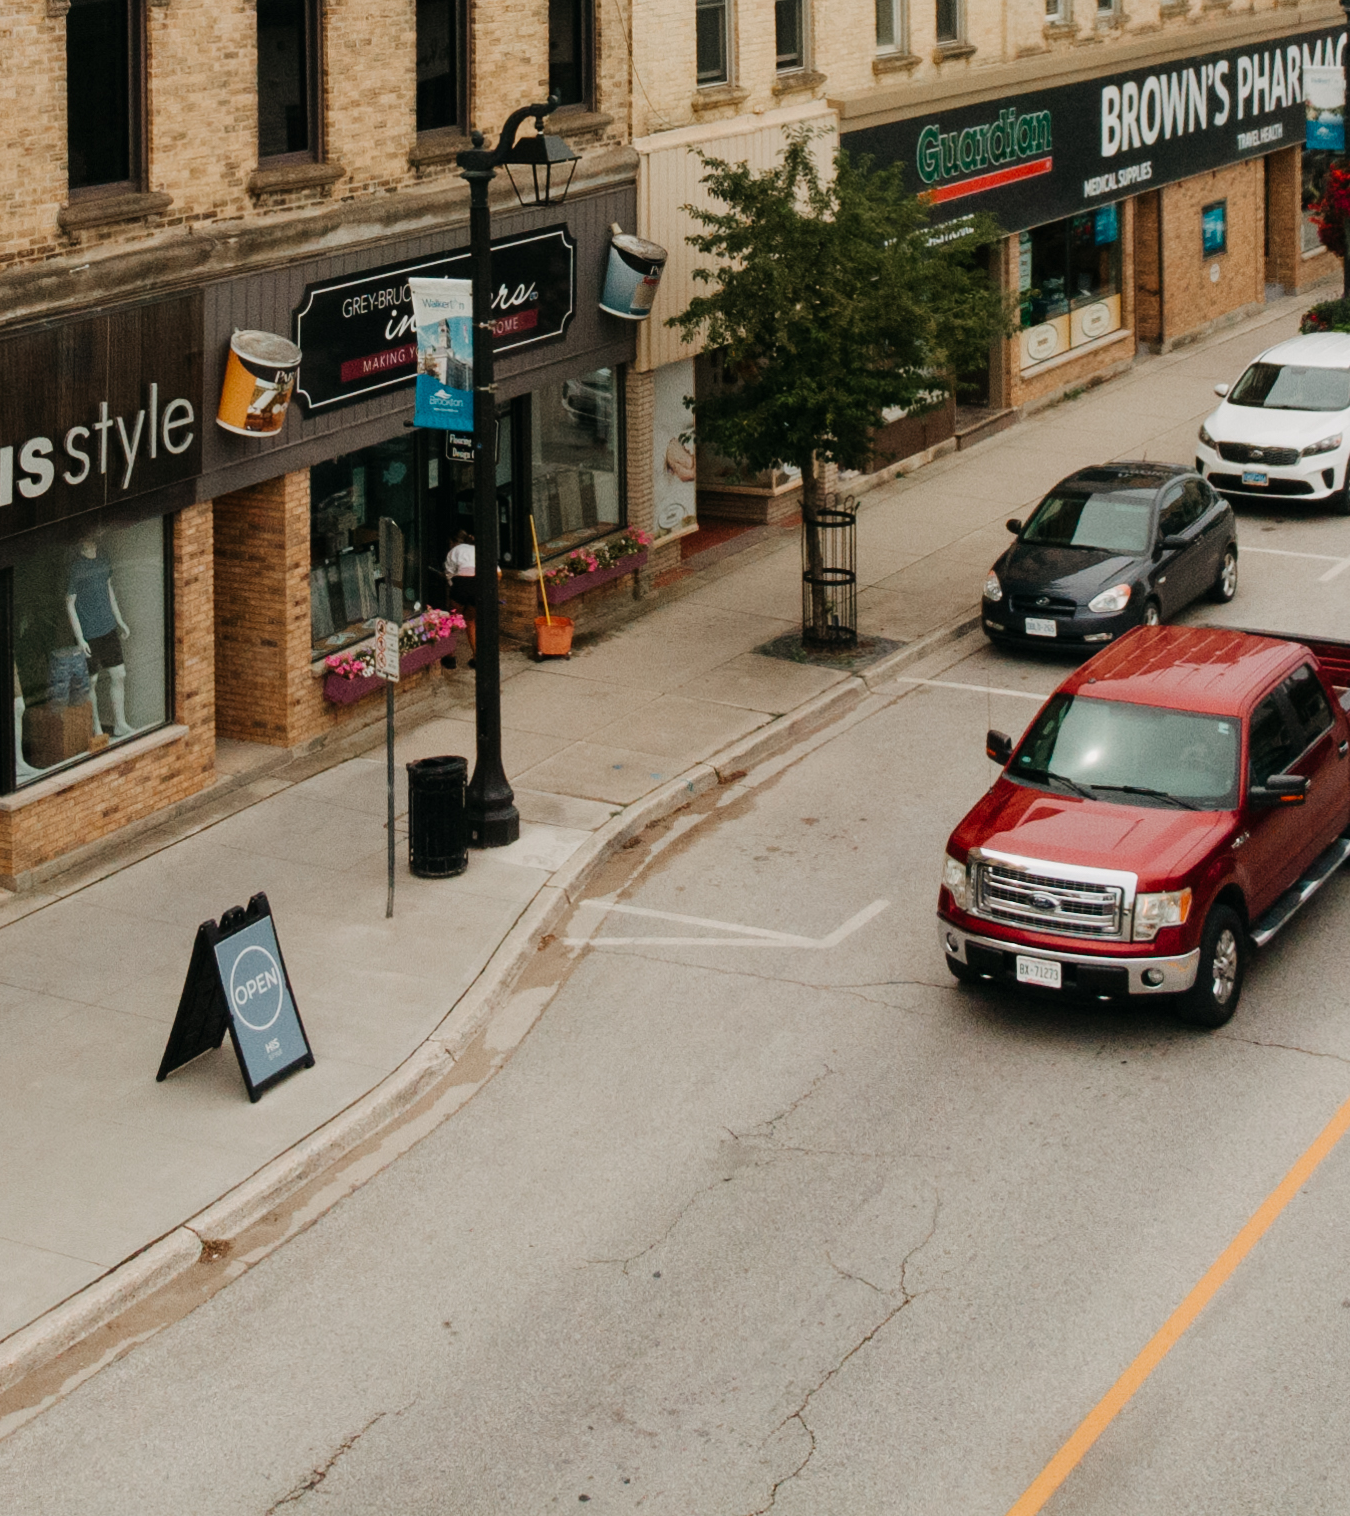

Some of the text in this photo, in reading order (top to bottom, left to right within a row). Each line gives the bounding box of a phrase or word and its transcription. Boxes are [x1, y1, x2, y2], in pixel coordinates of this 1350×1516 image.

[1101, 59, 1231, 158] BROWN'S
[916, 107, 1052, 184] Guardian
[1237, 122, 1284, 151] TRAVEL HEALTH
[1083, 161, 1152, 198] MEDICAL SUPPLIES
[342, 283, 414, 318] GREY-BRUC
[362, 350, 406, 373] MAKING
[235, 967, 279, 1005] OPEN
